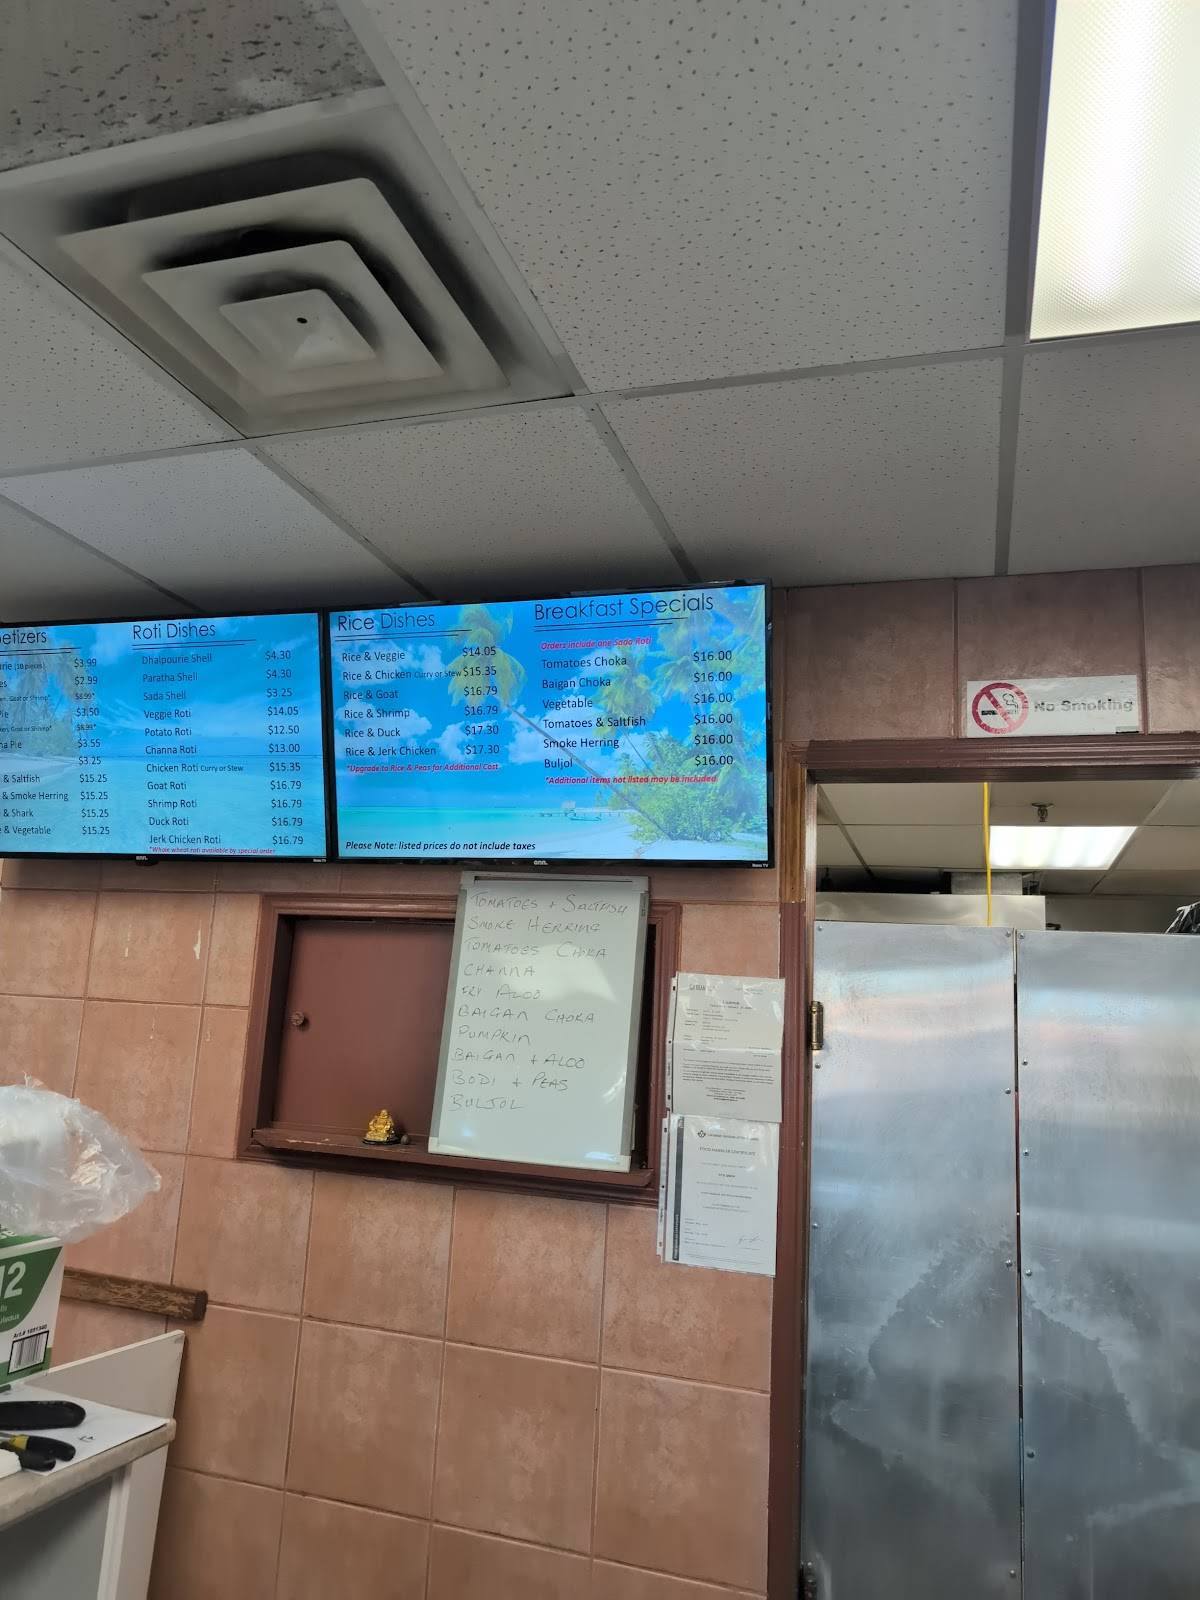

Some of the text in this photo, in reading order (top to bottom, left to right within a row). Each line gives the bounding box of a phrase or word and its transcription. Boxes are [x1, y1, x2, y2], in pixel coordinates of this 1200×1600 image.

[535, 593, 714, 620] Breakfast Specials
[338, 612, 435, 631] Rice Dishes
[0, 630, 46, 644] etizers
[133, 622, 216, 640] Roti Dishes
[142, 651, 291, 665] Dhalpourie Shell $4.30
[342, 646, 496, 662] Rice & Veggie $14.05
[542, 650, 732, 669] Tomatoes Choka $16.00
[143, 669, 291, 682] Paratha Shell $4.30
[343, 672, 362, 680] Rice
[365, 671, 372, 679] &
[375, 670, 411, 679] Chicken
[463, 666, 497, 677] $15.35
[75, 676, 97, 685] $2.99
[542, 672, 732, 691] Baigan Choka $16.00
[144, 688, 292, 700] Sada Shell $3.25
[343, 686, 497, 700] Rice & Goat $16.79
[543, 693, 732, 710] Vegetable $16.00
[1034, 699, 1133, 712] No Smoking
[77, 708, 99, 717] $3.50
[144, 706, 298, 720] Veggie Roti $14.05
[344, 706, 498, 719] Rice & Shrimp $16.79
[544, 714, 733, 729] Tomatoes & Saltfish $16.00
[145, 725, 299, 737] Potato Roti $12.50
[345, 725, 499, 738] Rice & Duck $17.30
[78, 739, 100, 748] $3.55
[544, 735, 733, 748] Smoke Herring $16.00
[145, 744, 300, 754] Channa Roti $13.00
[345, 744, 499, 757] Rice & Jerk Chicken $17.30
[79, 756, 101, 765] $3.25
[544, 756, 733, 769] Buljol $16.00
[147, 764, 179, 772] Chicken
[182, 763, 199, 771] Roti
[201, 765, 218, 773] Curry
[269, 762, 301, 772] $15.35
[432, 764, 442, 772] for
[12, 774, 40, 782] Saltfish
[80, 774, 107, 783] $15.25
[651, 776, 668, 784] may
[147, 782, 167, 790] Goat
[270, 781, 301, 790] $16.79
[39, 792, 68, 801] Herring
[80, 792, 108, 800] $15.25
[148, 800, 302, 809] Shrimp Roti $16.79
[3, 809, 109, 818] & Shark $15.25
[149, 817, 302, 826] Duck Roti $16.79
[12, 825, 51, 836] Vegetable
[82, 826, 110, 835] $15.25
[150, 835, 303, 845] Jerk Chicken Roti $16.79
[346, 841, 372, 850] Please
[375, 842, 397, 850] Note:
[423, 843, 448, 851] prices
[450, 842, 460, 850] do
[480, 842, 510, 850] include
[545, 1009, 594, 1023] CHOKA
[543, 1054, 585, 1068] ALOO
[532, 1072, 568, 1091] PEAS
